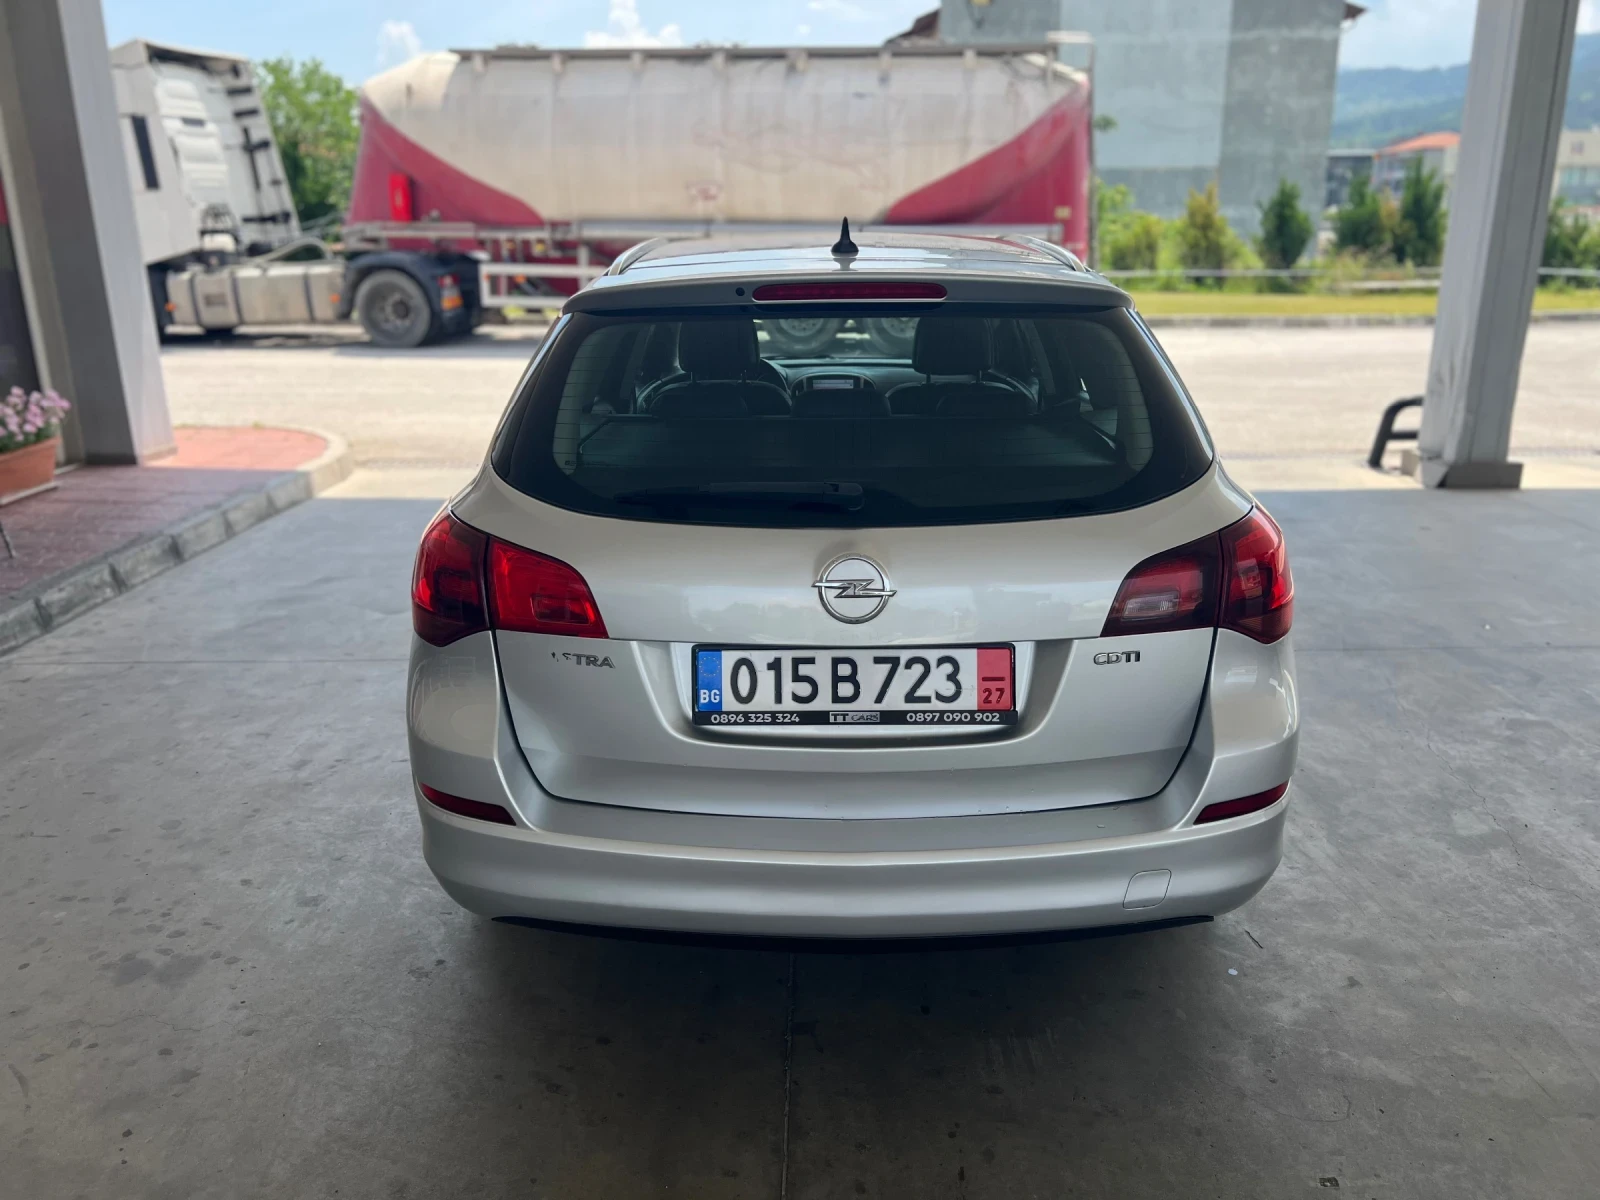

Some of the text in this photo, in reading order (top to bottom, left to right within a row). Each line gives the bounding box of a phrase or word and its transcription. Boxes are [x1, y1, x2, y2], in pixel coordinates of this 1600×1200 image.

[1093, 650, 1141, 666] CDTI
[699, 689, 720, 703] BG
[983, 687, 1006, 704] 27
[710, 713, 800, 723] 0896 325 324
[830, 713, 850, 722] TT
[906, 712, 1000, 722] 0897 090 902
